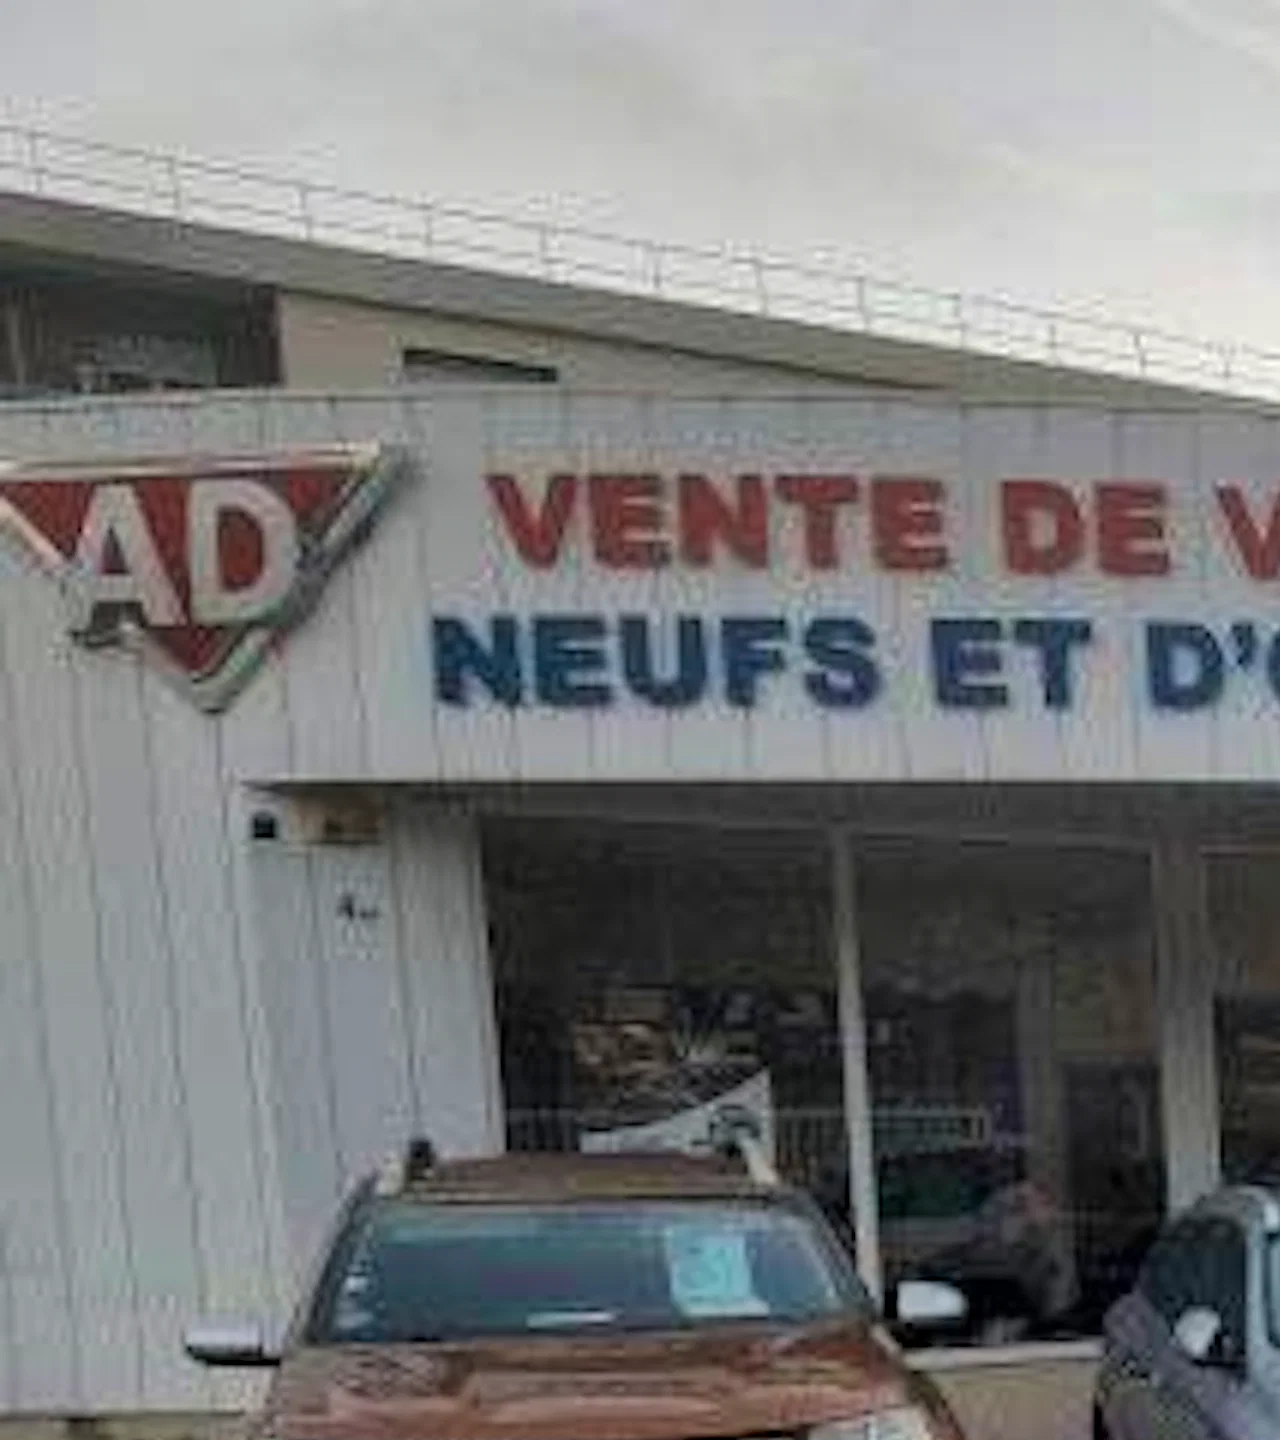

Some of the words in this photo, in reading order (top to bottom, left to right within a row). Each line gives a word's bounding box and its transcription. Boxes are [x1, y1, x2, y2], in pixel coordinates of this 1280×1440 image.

[76, 476, 308, 632] AD
[485, 472, 950, 573] VENTE
[998, 480, 1172, 578] DE
[430, 615, 880, 708] NEUFS
[930, 618, 1092, 712] ET
